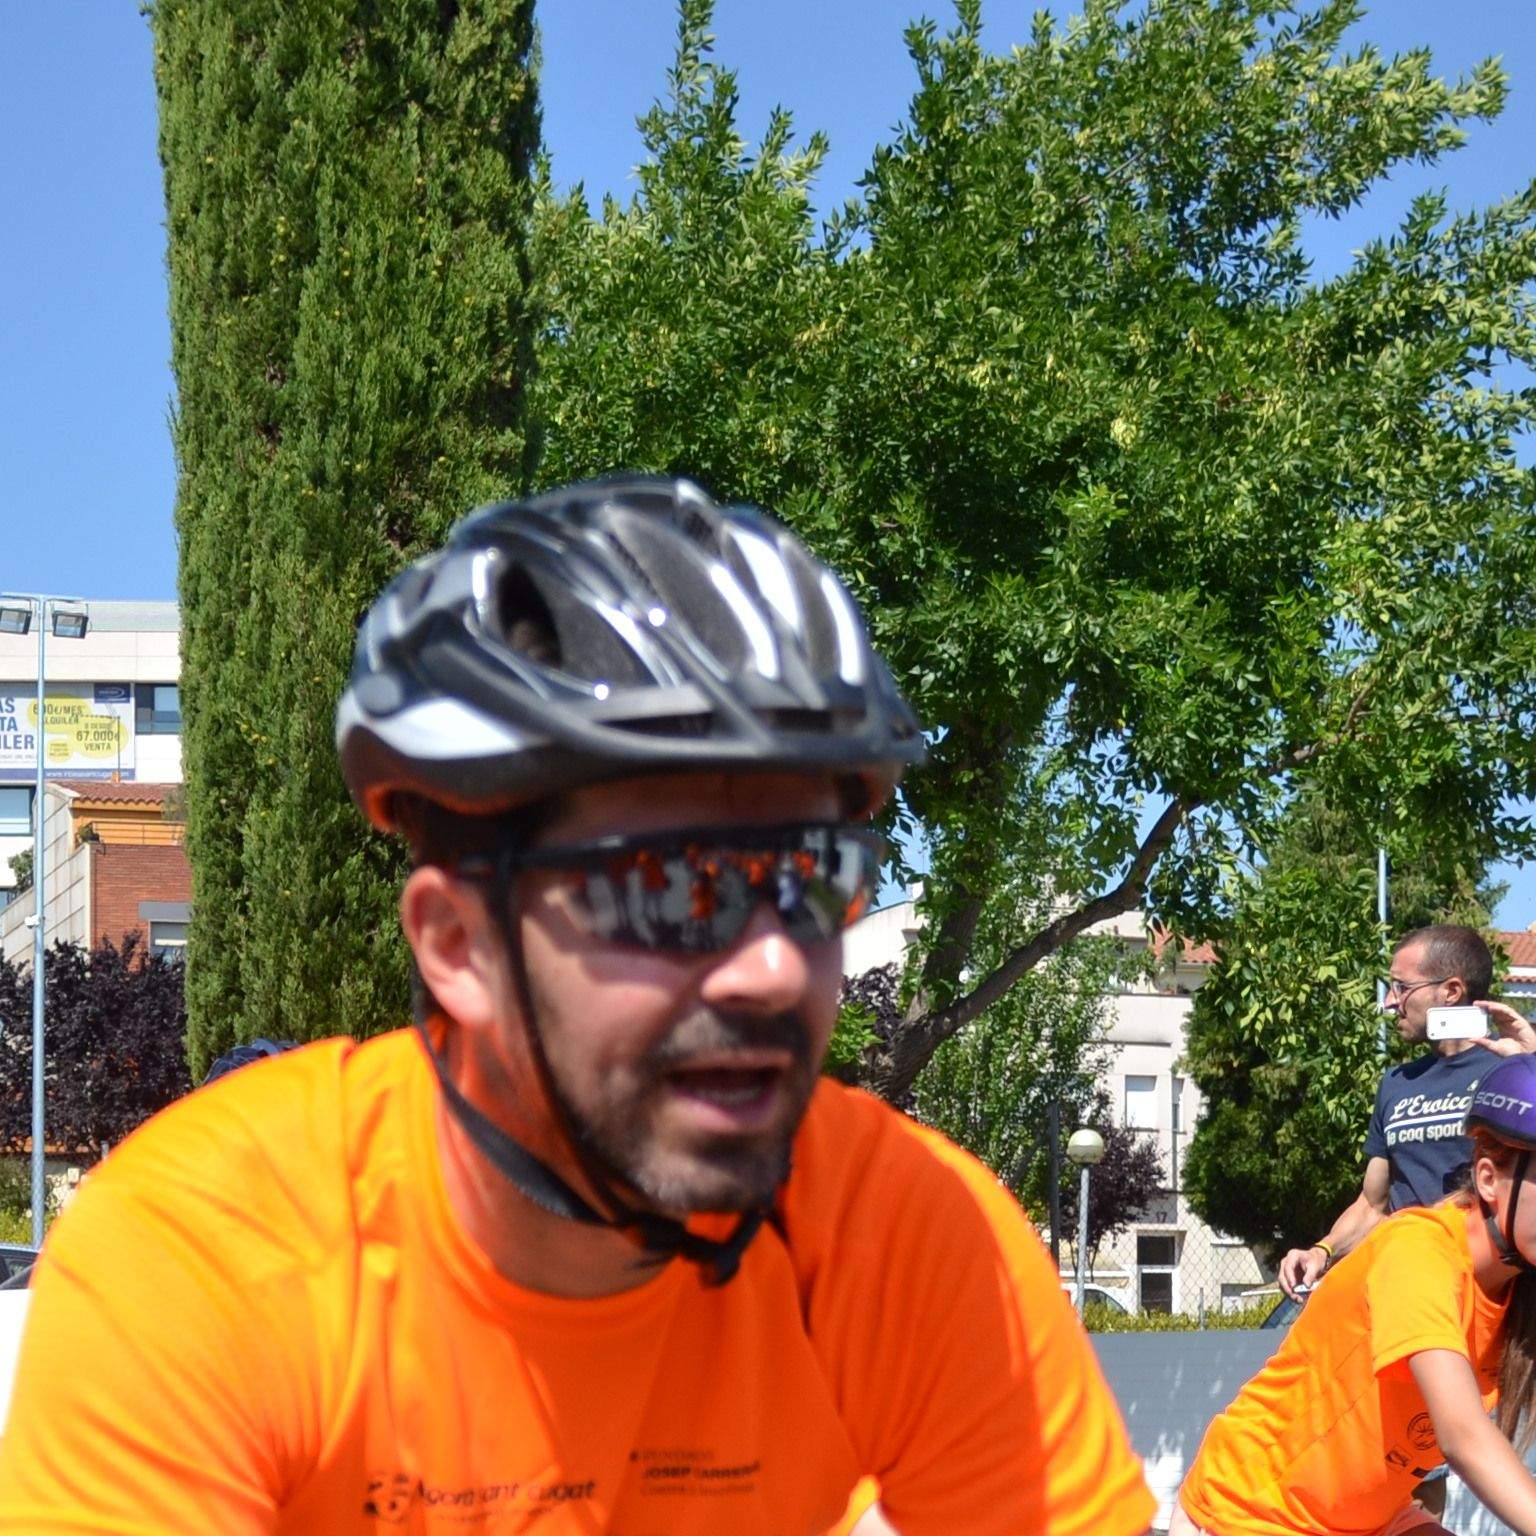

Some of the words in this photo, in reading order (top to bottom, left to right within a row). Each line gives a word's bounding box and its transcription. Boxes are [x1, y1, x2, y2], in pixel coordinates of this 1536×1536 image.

[84, 742, 111, 752] VENTA
[1474, 1091, 1535, 1117] SCOTT
[1398, 1128, 1425, 1144] coq
